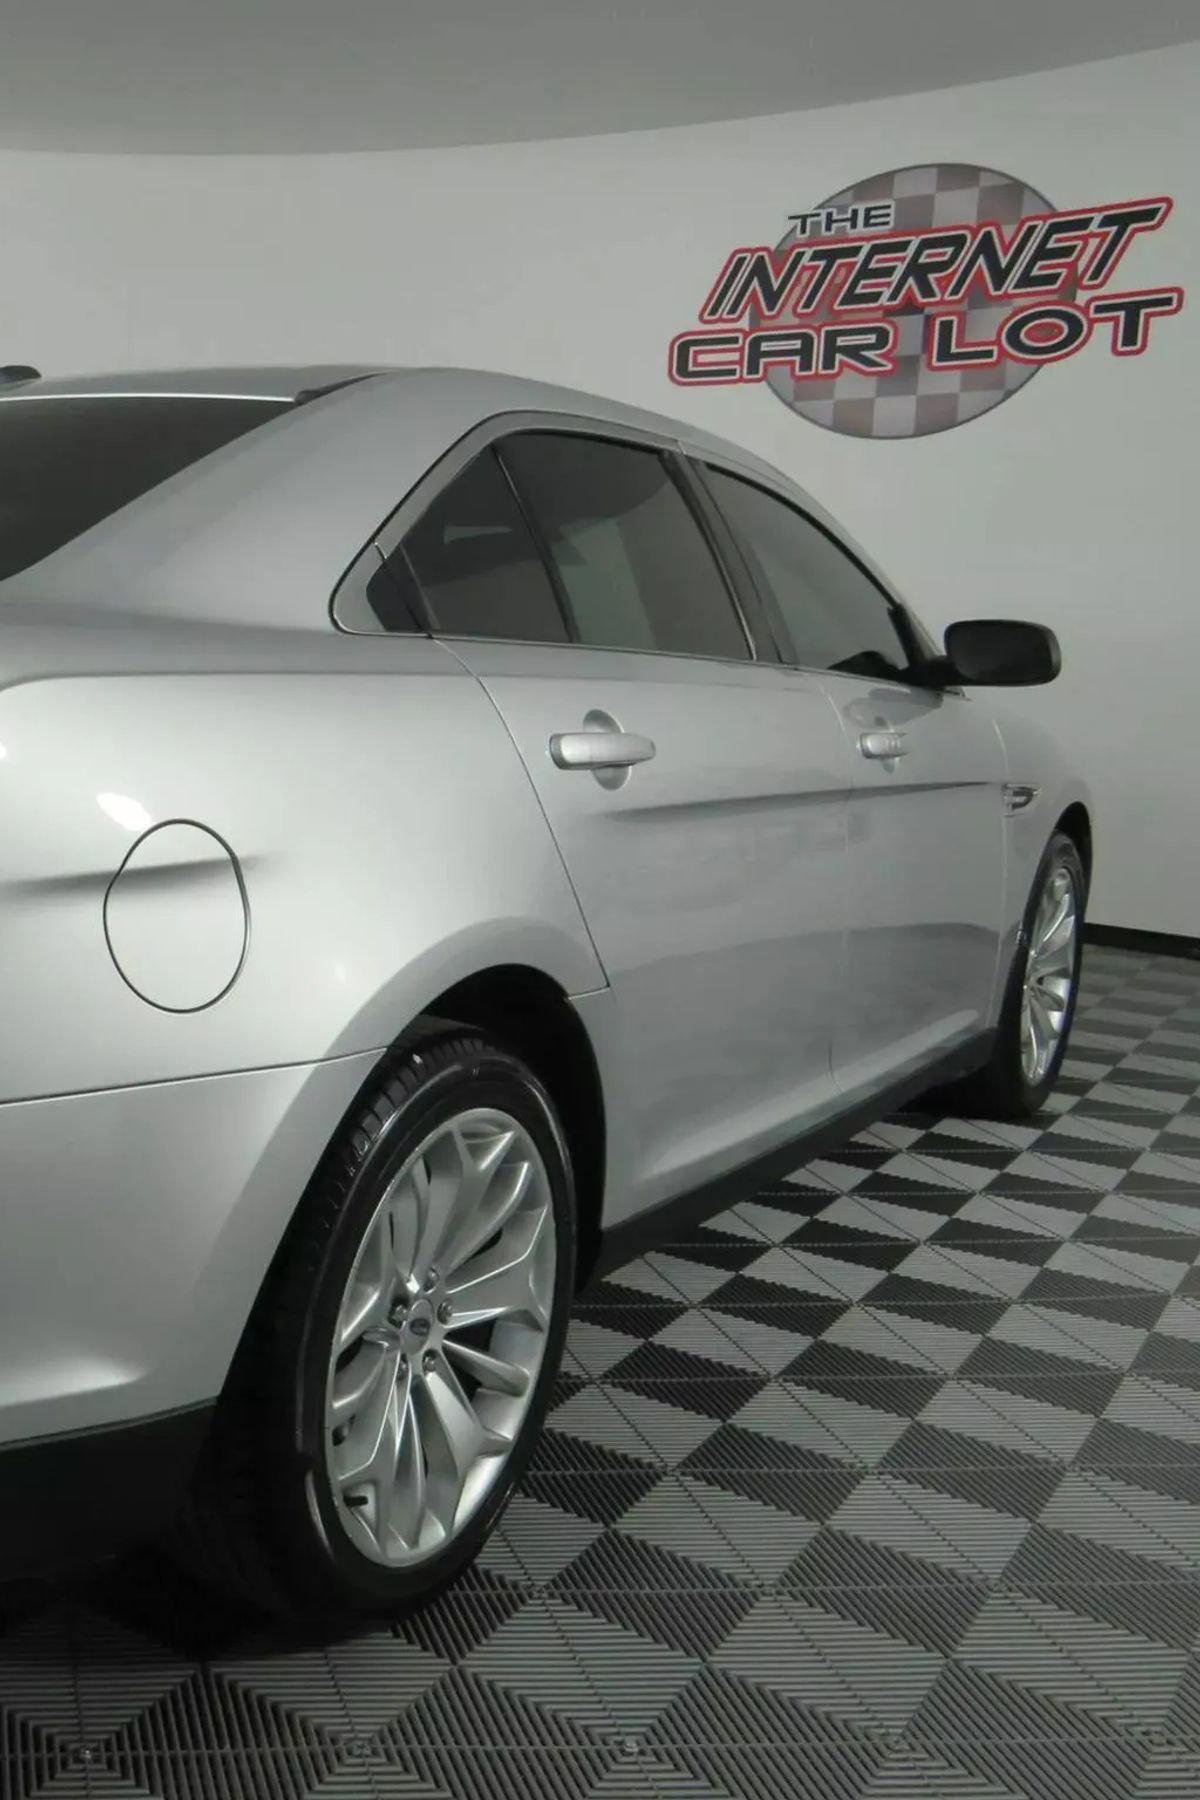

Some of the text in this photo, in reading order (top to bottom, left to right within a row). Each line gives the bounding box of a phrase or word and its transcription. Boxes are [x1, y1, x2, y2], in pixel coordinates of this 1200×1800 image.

[703, 201, 1169, 320] INTERNET
[787, 203, 893, 236] THE
[672, 291, 1179, 382] CAR LOT
